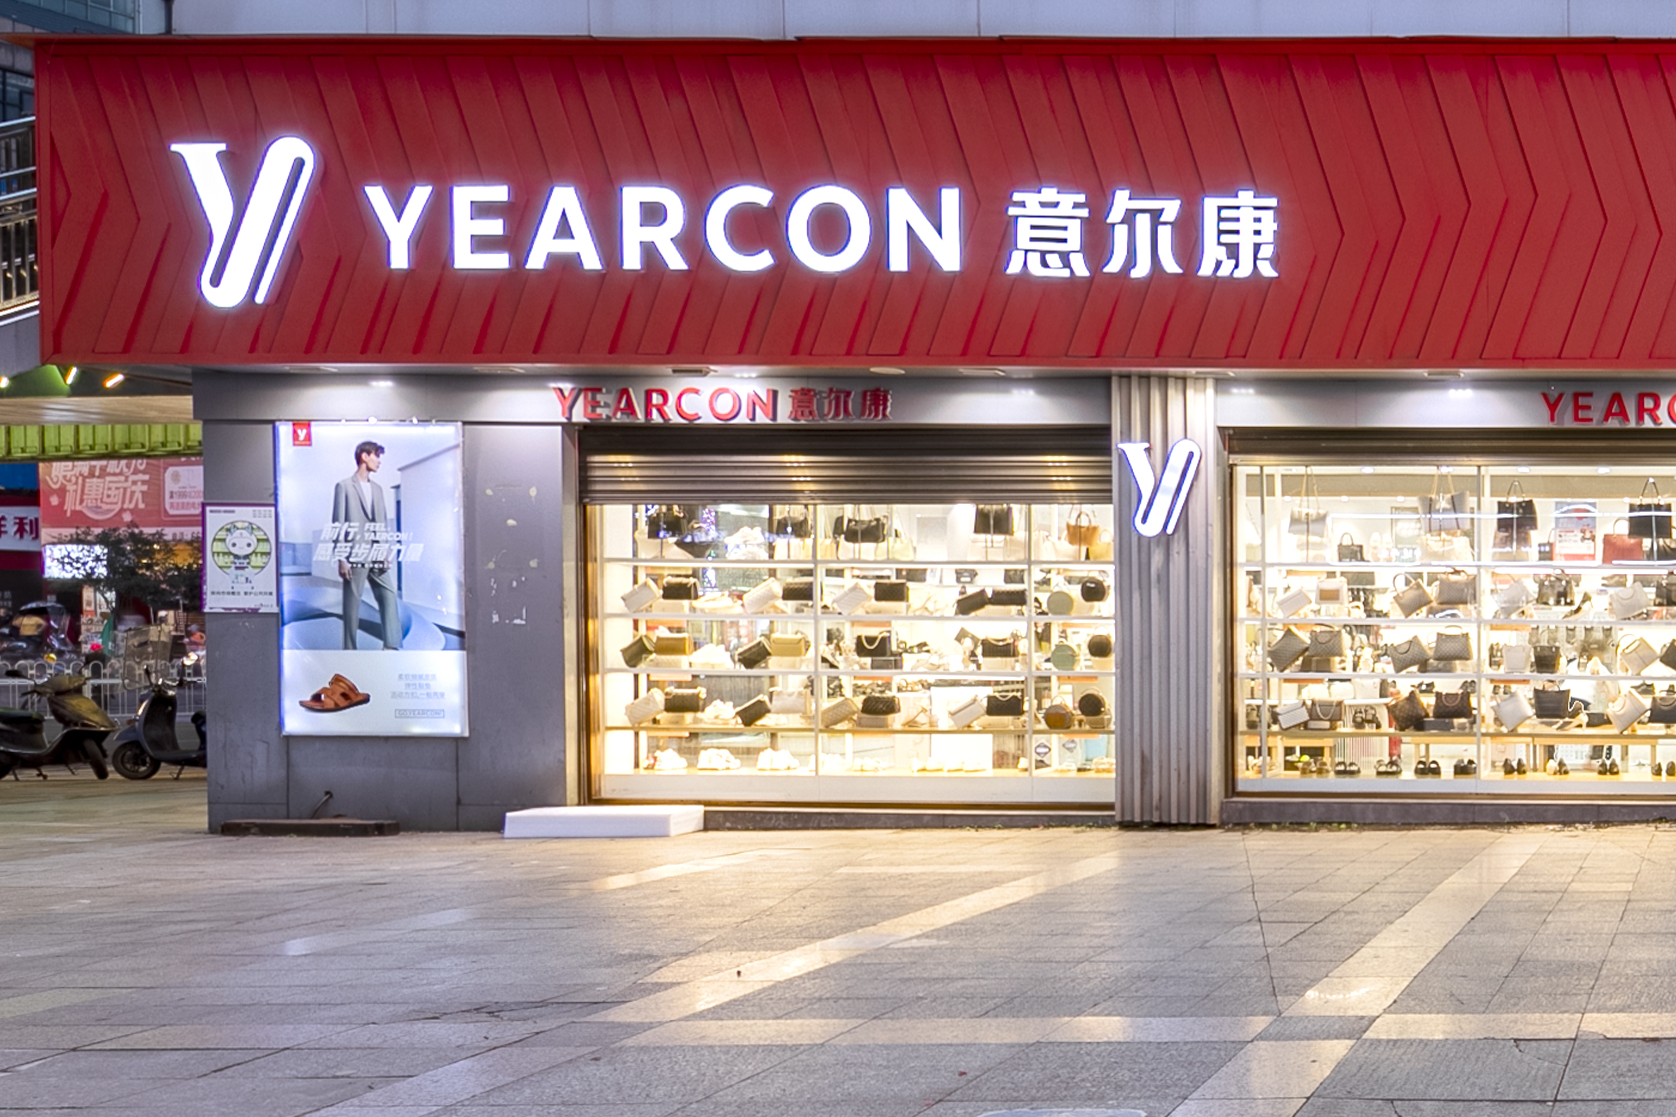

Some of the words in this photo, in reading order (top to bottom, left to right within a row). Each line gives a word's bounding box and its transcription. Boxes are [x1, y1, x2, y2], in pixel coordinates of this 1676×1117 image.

[363, 184, 961, 273] YEARCON
[1005, 186, 1280, 279] 意尔康
[553, 386, 778, 422] YEARCON
[787, 387, 893, 422] 意尔康
